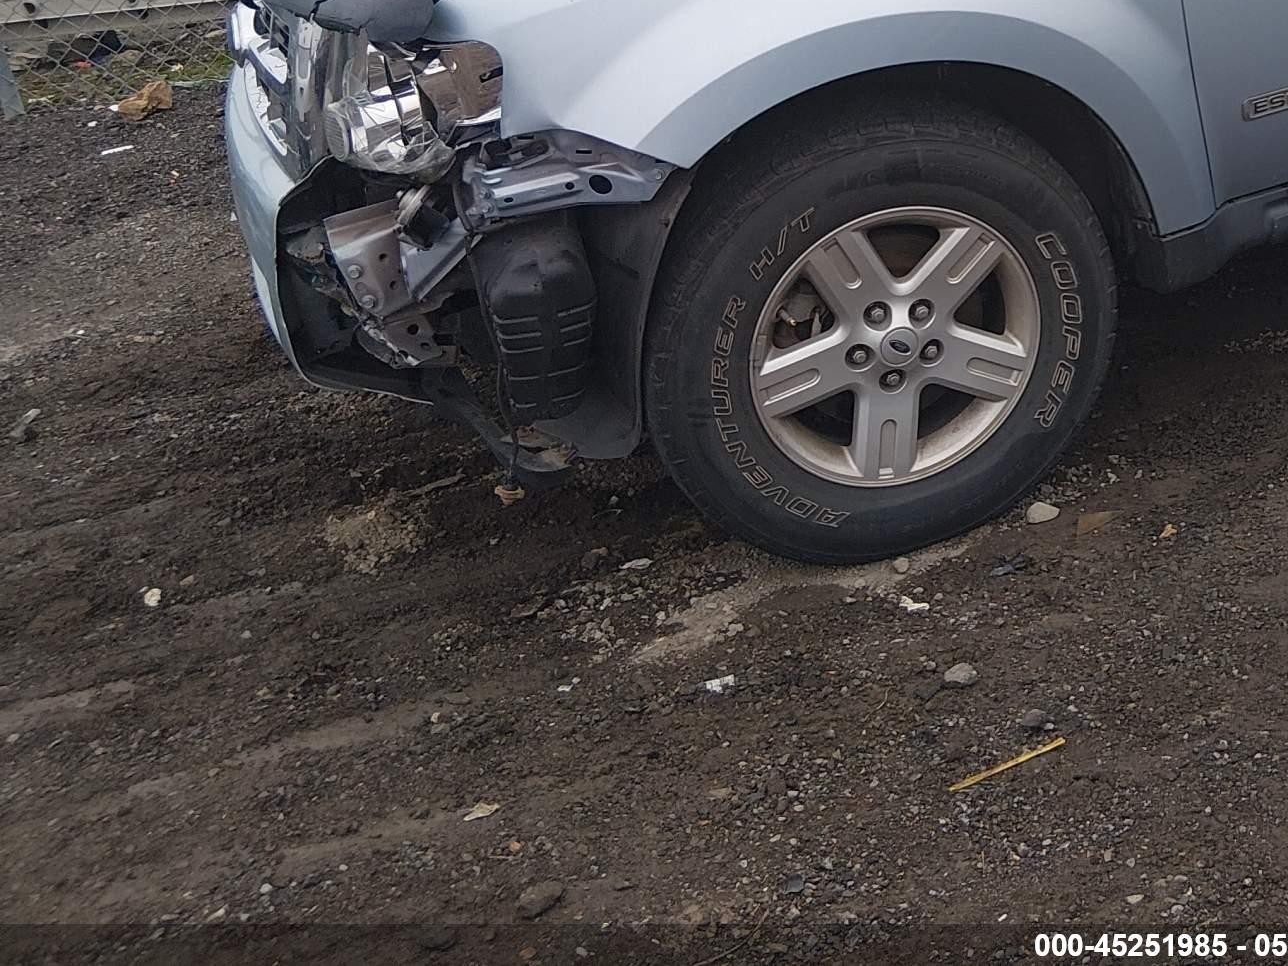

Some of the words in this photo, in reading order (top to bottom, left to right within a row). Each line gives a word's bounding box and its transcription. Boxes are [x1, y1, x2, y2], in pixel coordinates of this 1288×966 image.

[748, 207, 817, 281] H/T
[1033, 232, 1083, 430] COOPER
[710, 295, 853, 528] ADVENTURER
